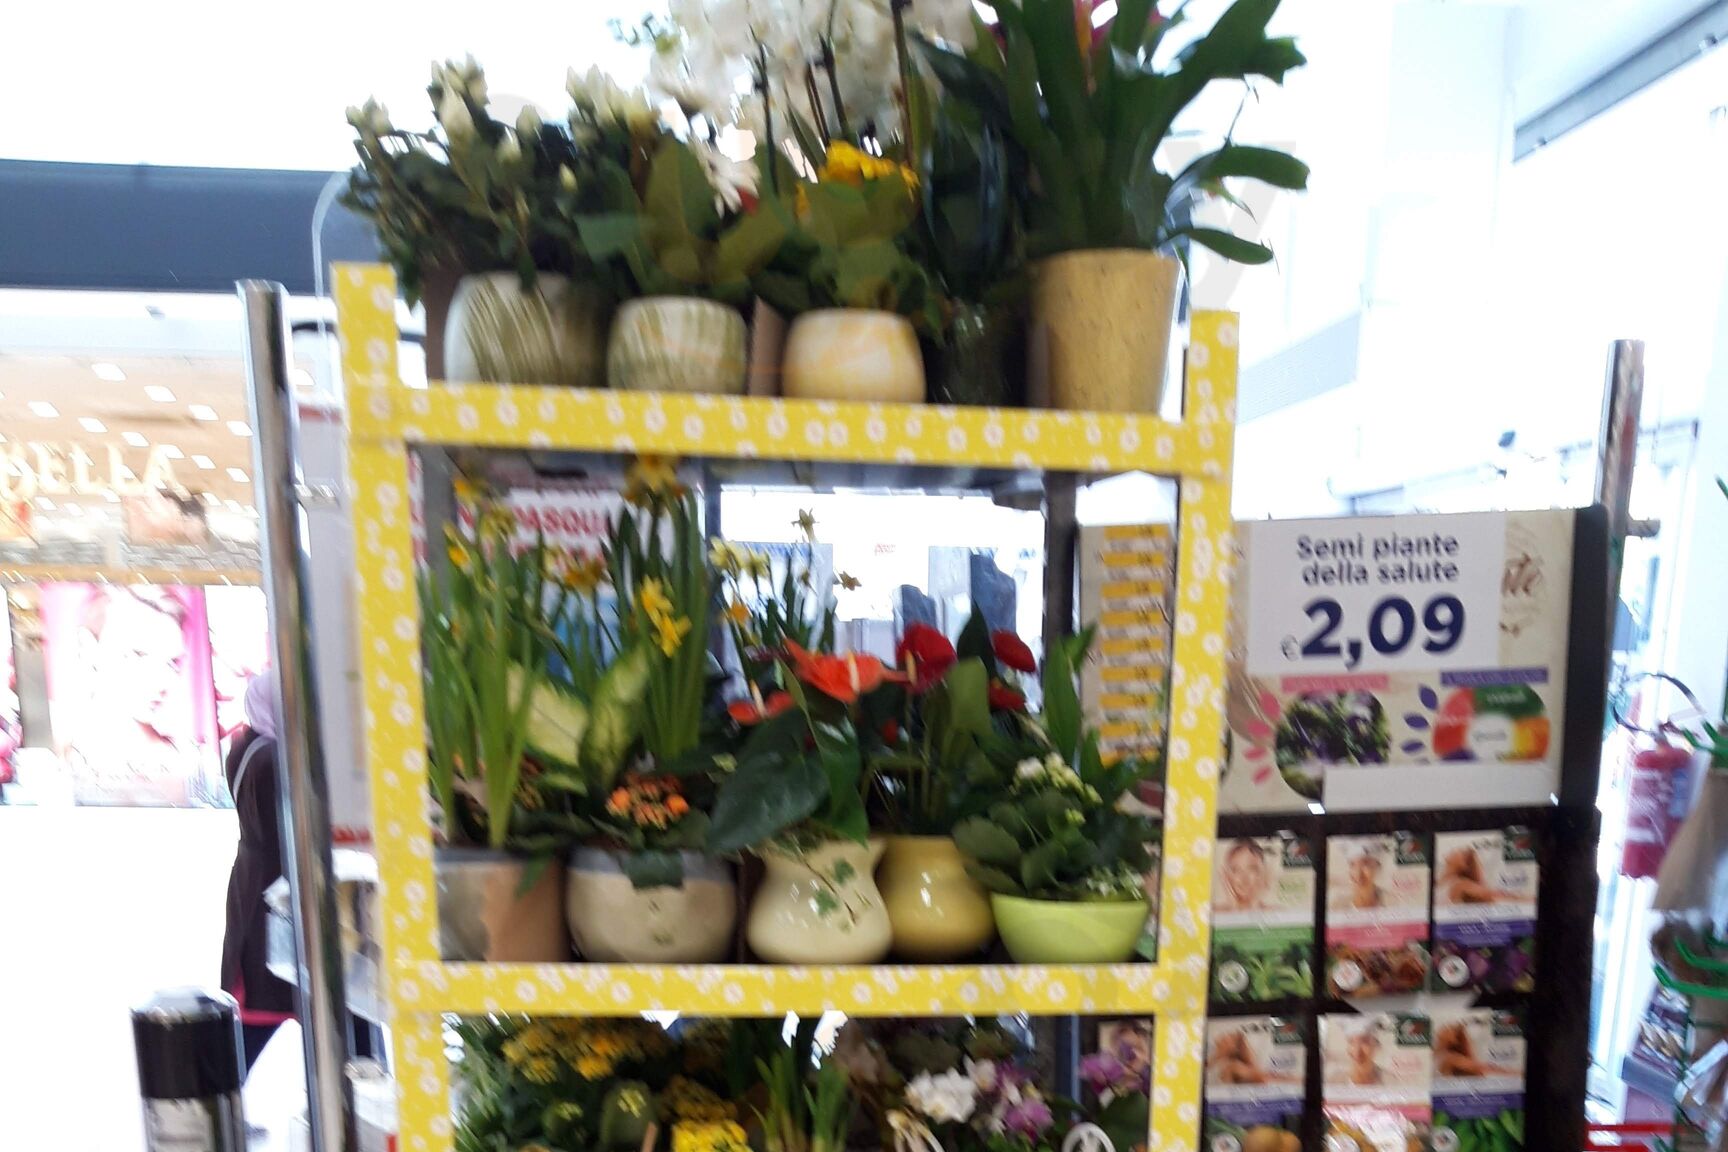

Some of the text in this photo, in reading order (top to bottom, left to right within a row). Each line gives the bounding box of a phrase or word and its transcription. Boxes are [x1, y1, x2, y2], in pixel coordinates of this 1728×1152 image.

[1297, 532, 1459, 561] Semi piante
[1302, 561, 1459, 585] della salute
